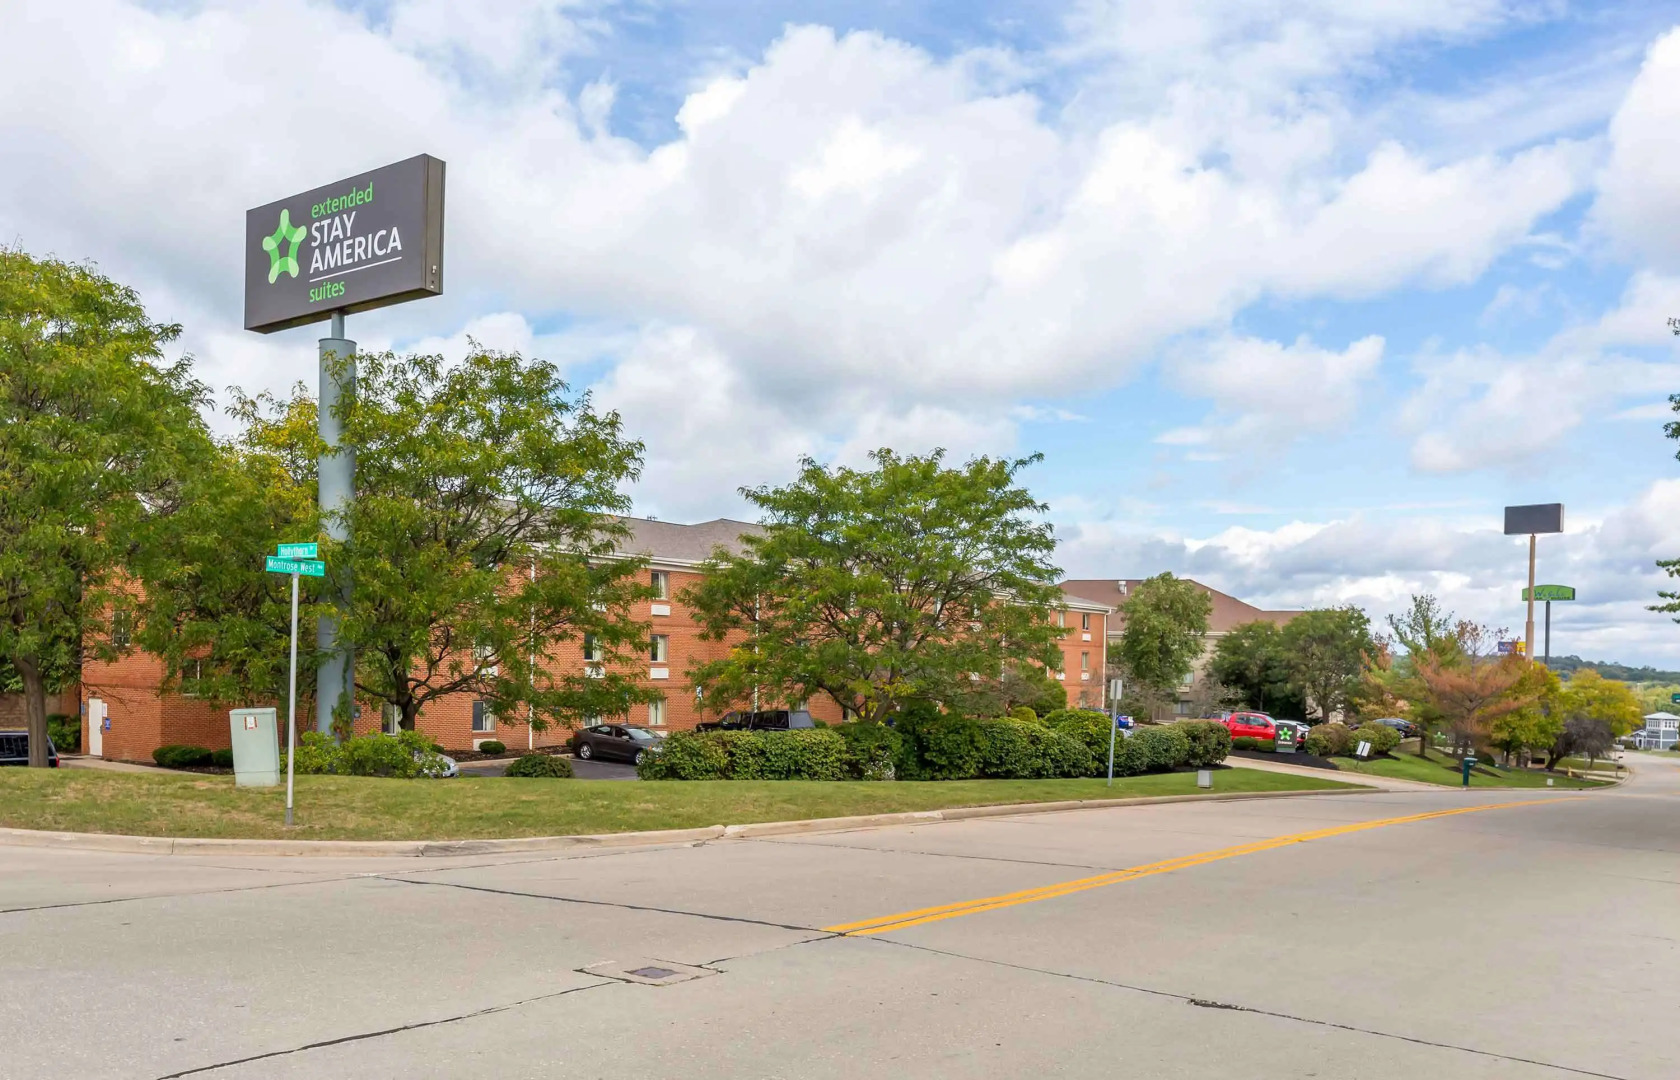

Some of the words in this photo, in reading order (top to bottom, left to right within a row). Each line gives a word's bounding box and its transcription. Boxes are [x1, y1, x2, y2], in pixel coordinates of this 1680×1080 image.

[311, 181, 373, 219] extended
[311, 211, 356, 247] STAY
[309, 226, 402, 274] AMERICA
[309, 281, 345, 303] suites
[268, 559, 298, 570] Montrose
[300, 563, 315, 573] West
